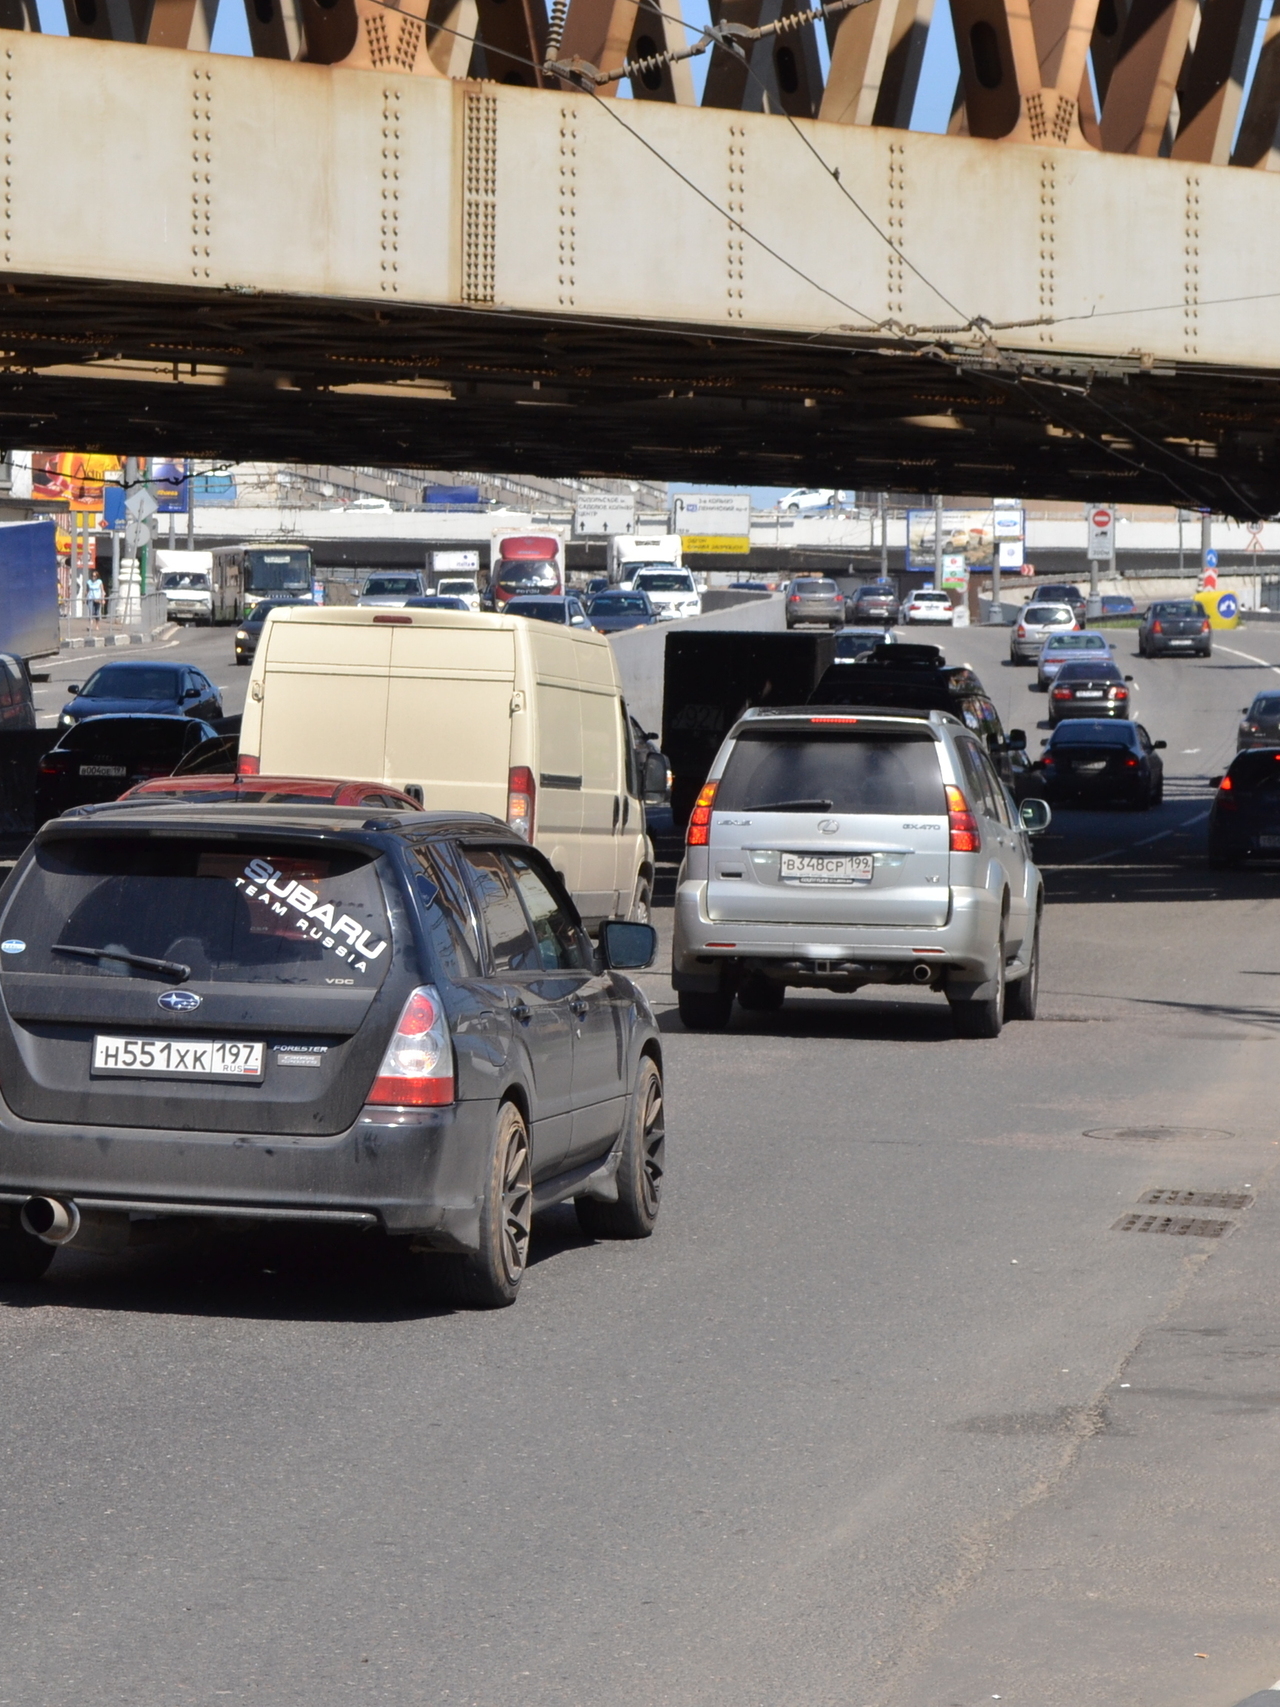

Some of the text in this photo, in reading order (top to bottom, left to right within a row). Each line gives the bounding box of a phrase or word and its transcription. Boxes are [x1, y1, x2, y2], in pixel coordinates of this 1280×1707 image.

[786, 856, 869, 872] В348СР 199
[243, 858, 388, 960] SUBARU
[234, 877, 367, 974] TEAM RUSSIA
[323, 978, 355, 986] VDC
[104, 1041, 255, 1071] Н551ХК 197
[272, 1044, 329, 1053] FORESTER
[223, 1064, 243, 1073] RUS
